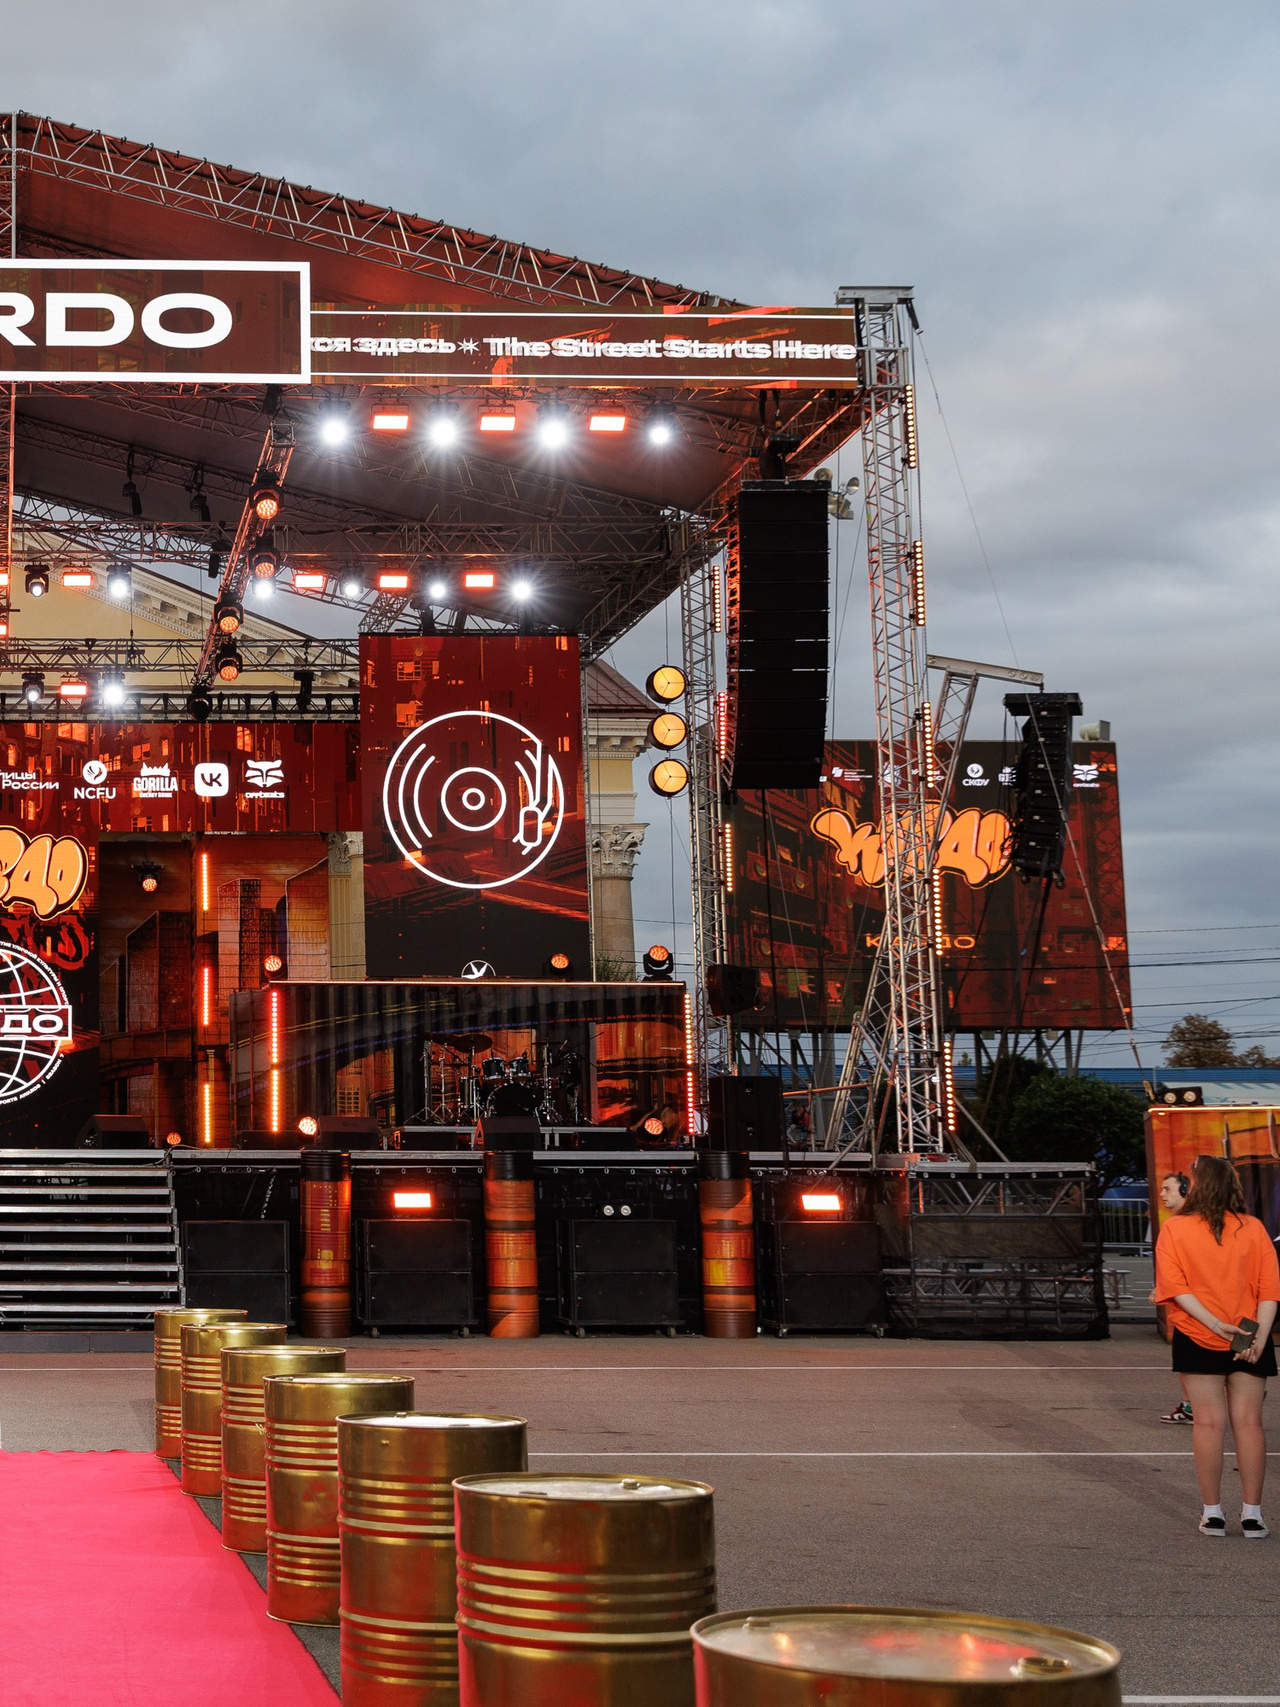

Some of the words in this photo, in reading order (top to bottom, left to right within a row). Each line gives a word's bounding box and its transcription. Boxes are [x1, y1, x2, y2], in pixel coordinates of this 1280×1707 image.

[352, 337, 456, 356] здесь
[483, 337, 551, 357] The
[552, 338, 663, 358] Street
[662, 339, 771, 359] Starts
[773, 340, 857, 360] Here
[133, 777, 178, 792] GORILLA
[962, 778, 990, 787] СКФУ
[73, 787, 116, 799] NCFU
